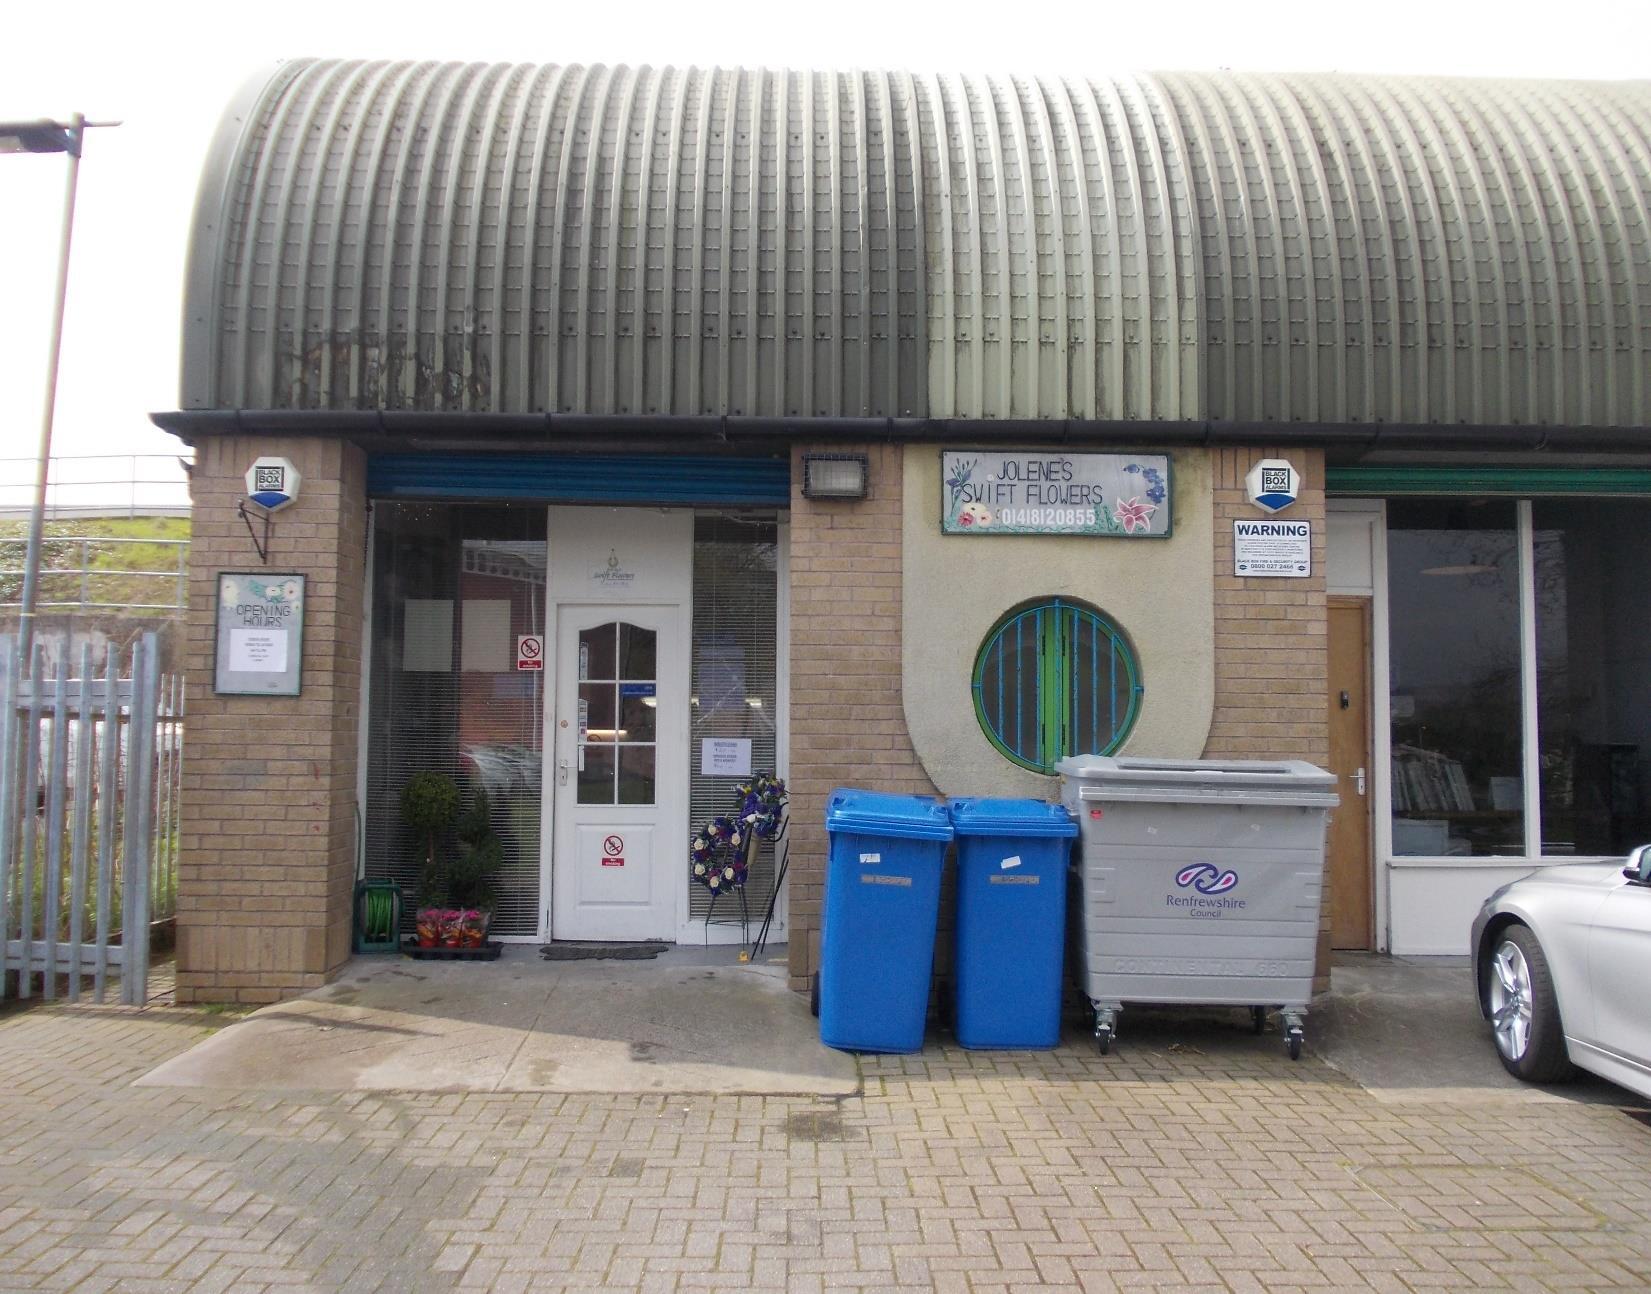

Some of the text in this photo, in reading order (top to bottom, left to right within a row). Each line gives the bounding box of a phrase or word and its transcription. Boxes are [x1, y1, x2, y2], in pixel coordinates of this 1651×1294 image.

[997, 458, 1073, 482] JOLENE'S
[259, 475, 280, 484] BOX
[1265, 477, 1286, 485] BOX
[961, 483, 1103, 505] SWIFT FLOWERS
[1002, 508, 1096, 526] 01418120855
[1237, 524, 1308, 537] WARNING
[236, 604, 291, 617] OPENING
[243, 615, 282, 627] HOURS
[1166, 894, 1246, 908] Renfrewshire
[1190, 908, 1221, 917] Council
